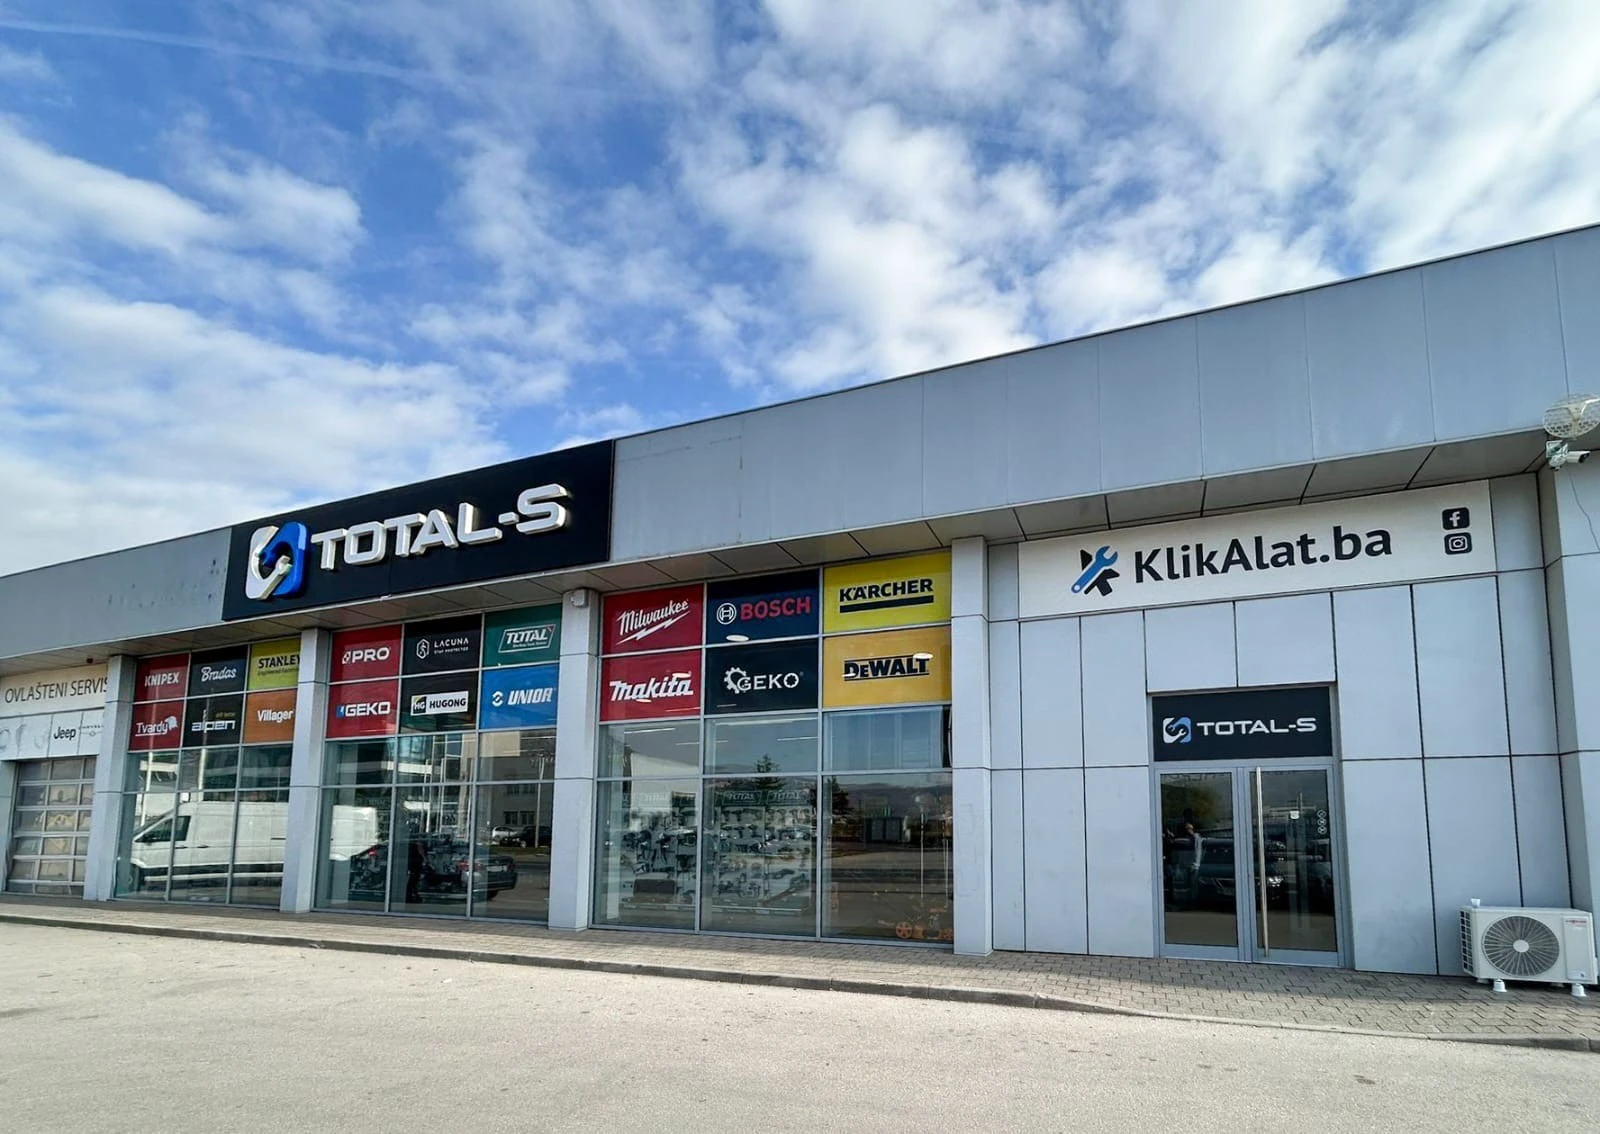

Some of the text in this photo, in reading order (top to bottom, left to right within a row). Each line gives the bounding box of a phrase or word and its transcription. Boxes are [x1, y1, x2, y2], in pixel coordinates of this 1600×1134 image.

[311, 483, 571, 571] TOTAL-S
[1135, 525, 1393, 584] KlikAlat.ba
[840, 578, 933, 602] KÄRCHER
[616, 599, 689, 636] Milwaukee
[740, 597, 811, 621] BOSCH
[434, 637, 469, 648] LACUNA
[506, 628, 548, 645] TOTAL
[352, 647, 391, 663] PRO
[144, 672, 180, 687] KNIPEX
[200, 666, 237, 682] Bradas
[737, 672, 799, 692] GEKO
[5, 681, 68, 704] OVLAŠTENI
[508, 687, 553, 704] UNIOR
[345, 701, 391, 717] GEKO
[429, 697, 467, 710] HUGONG
[257, 709, 294, 723] Villager
[53, 726, 77, 741] Jeep
[135, 719, 168, 736] Tvardy
[1197, 717, 1318, 737] TOTAL-S
